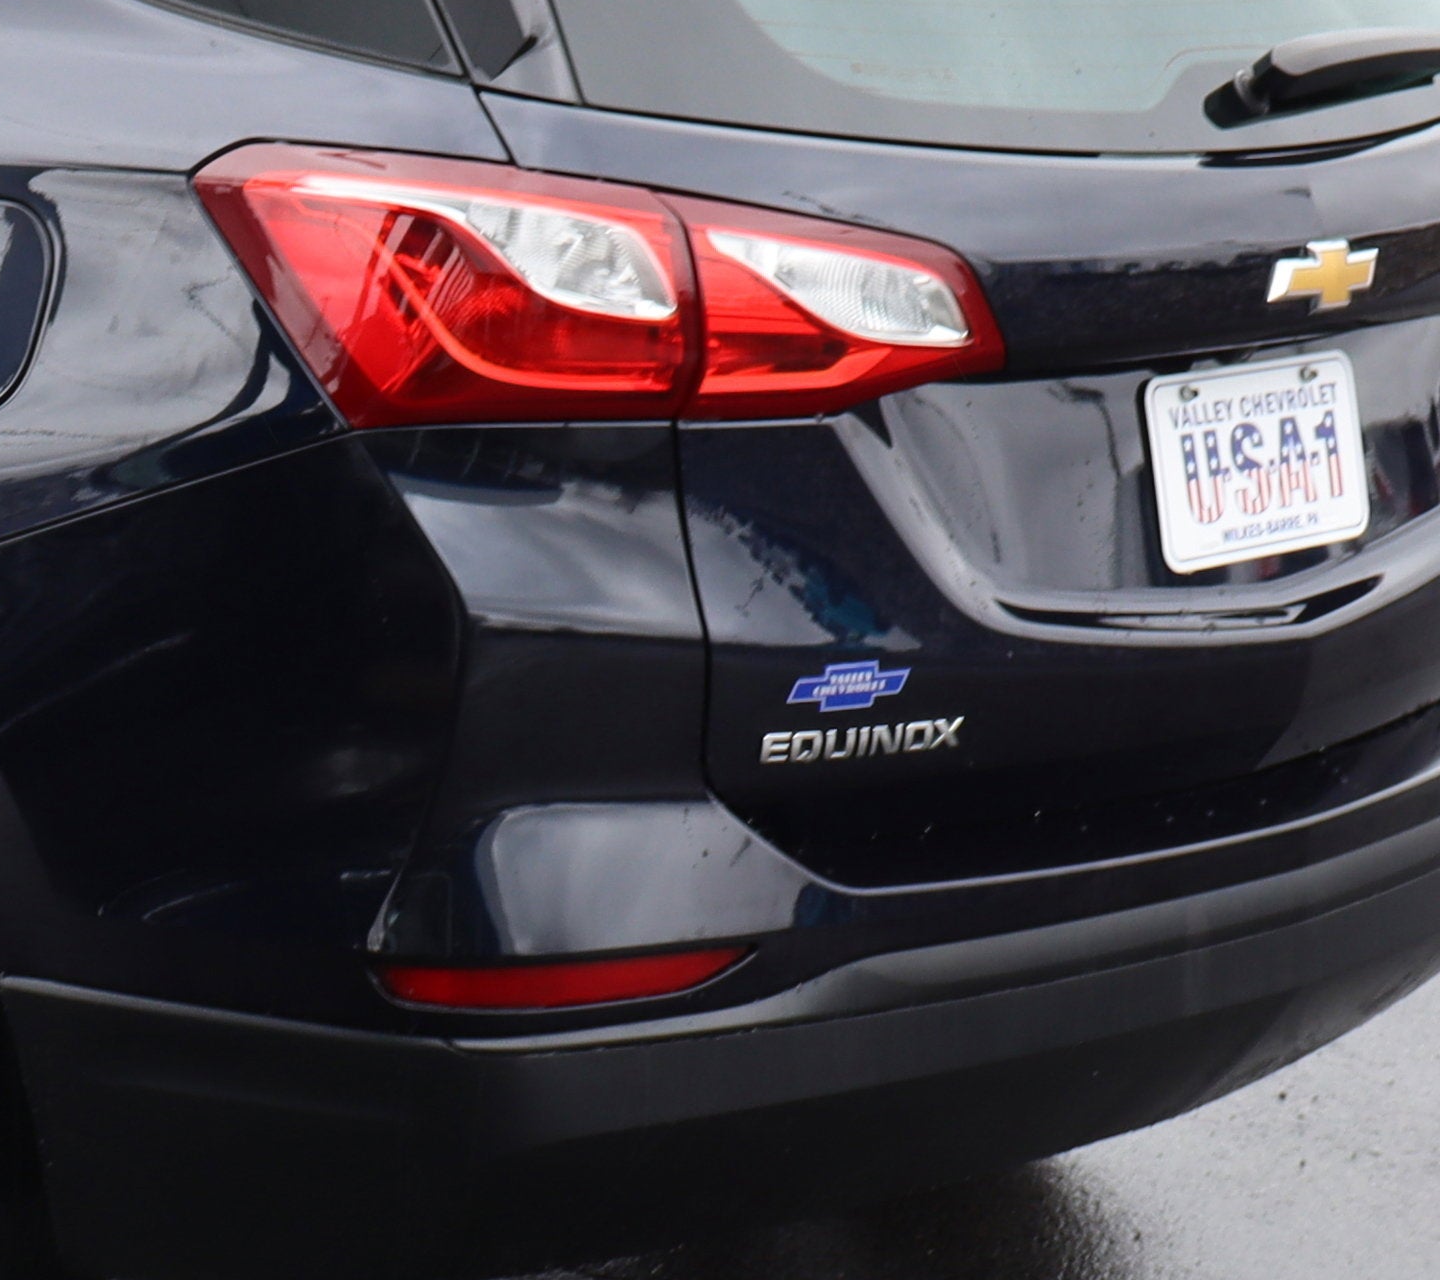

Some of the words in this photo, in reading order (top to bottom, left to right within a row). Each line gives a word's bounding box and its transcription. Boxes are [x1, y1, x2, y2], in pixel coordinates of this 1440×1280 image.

[1171, 399, 1233, 429] VALLEY
[1240, 383, 1336, 418] CHEVROLET
[760, 716, 965, 764] EQUINOX
